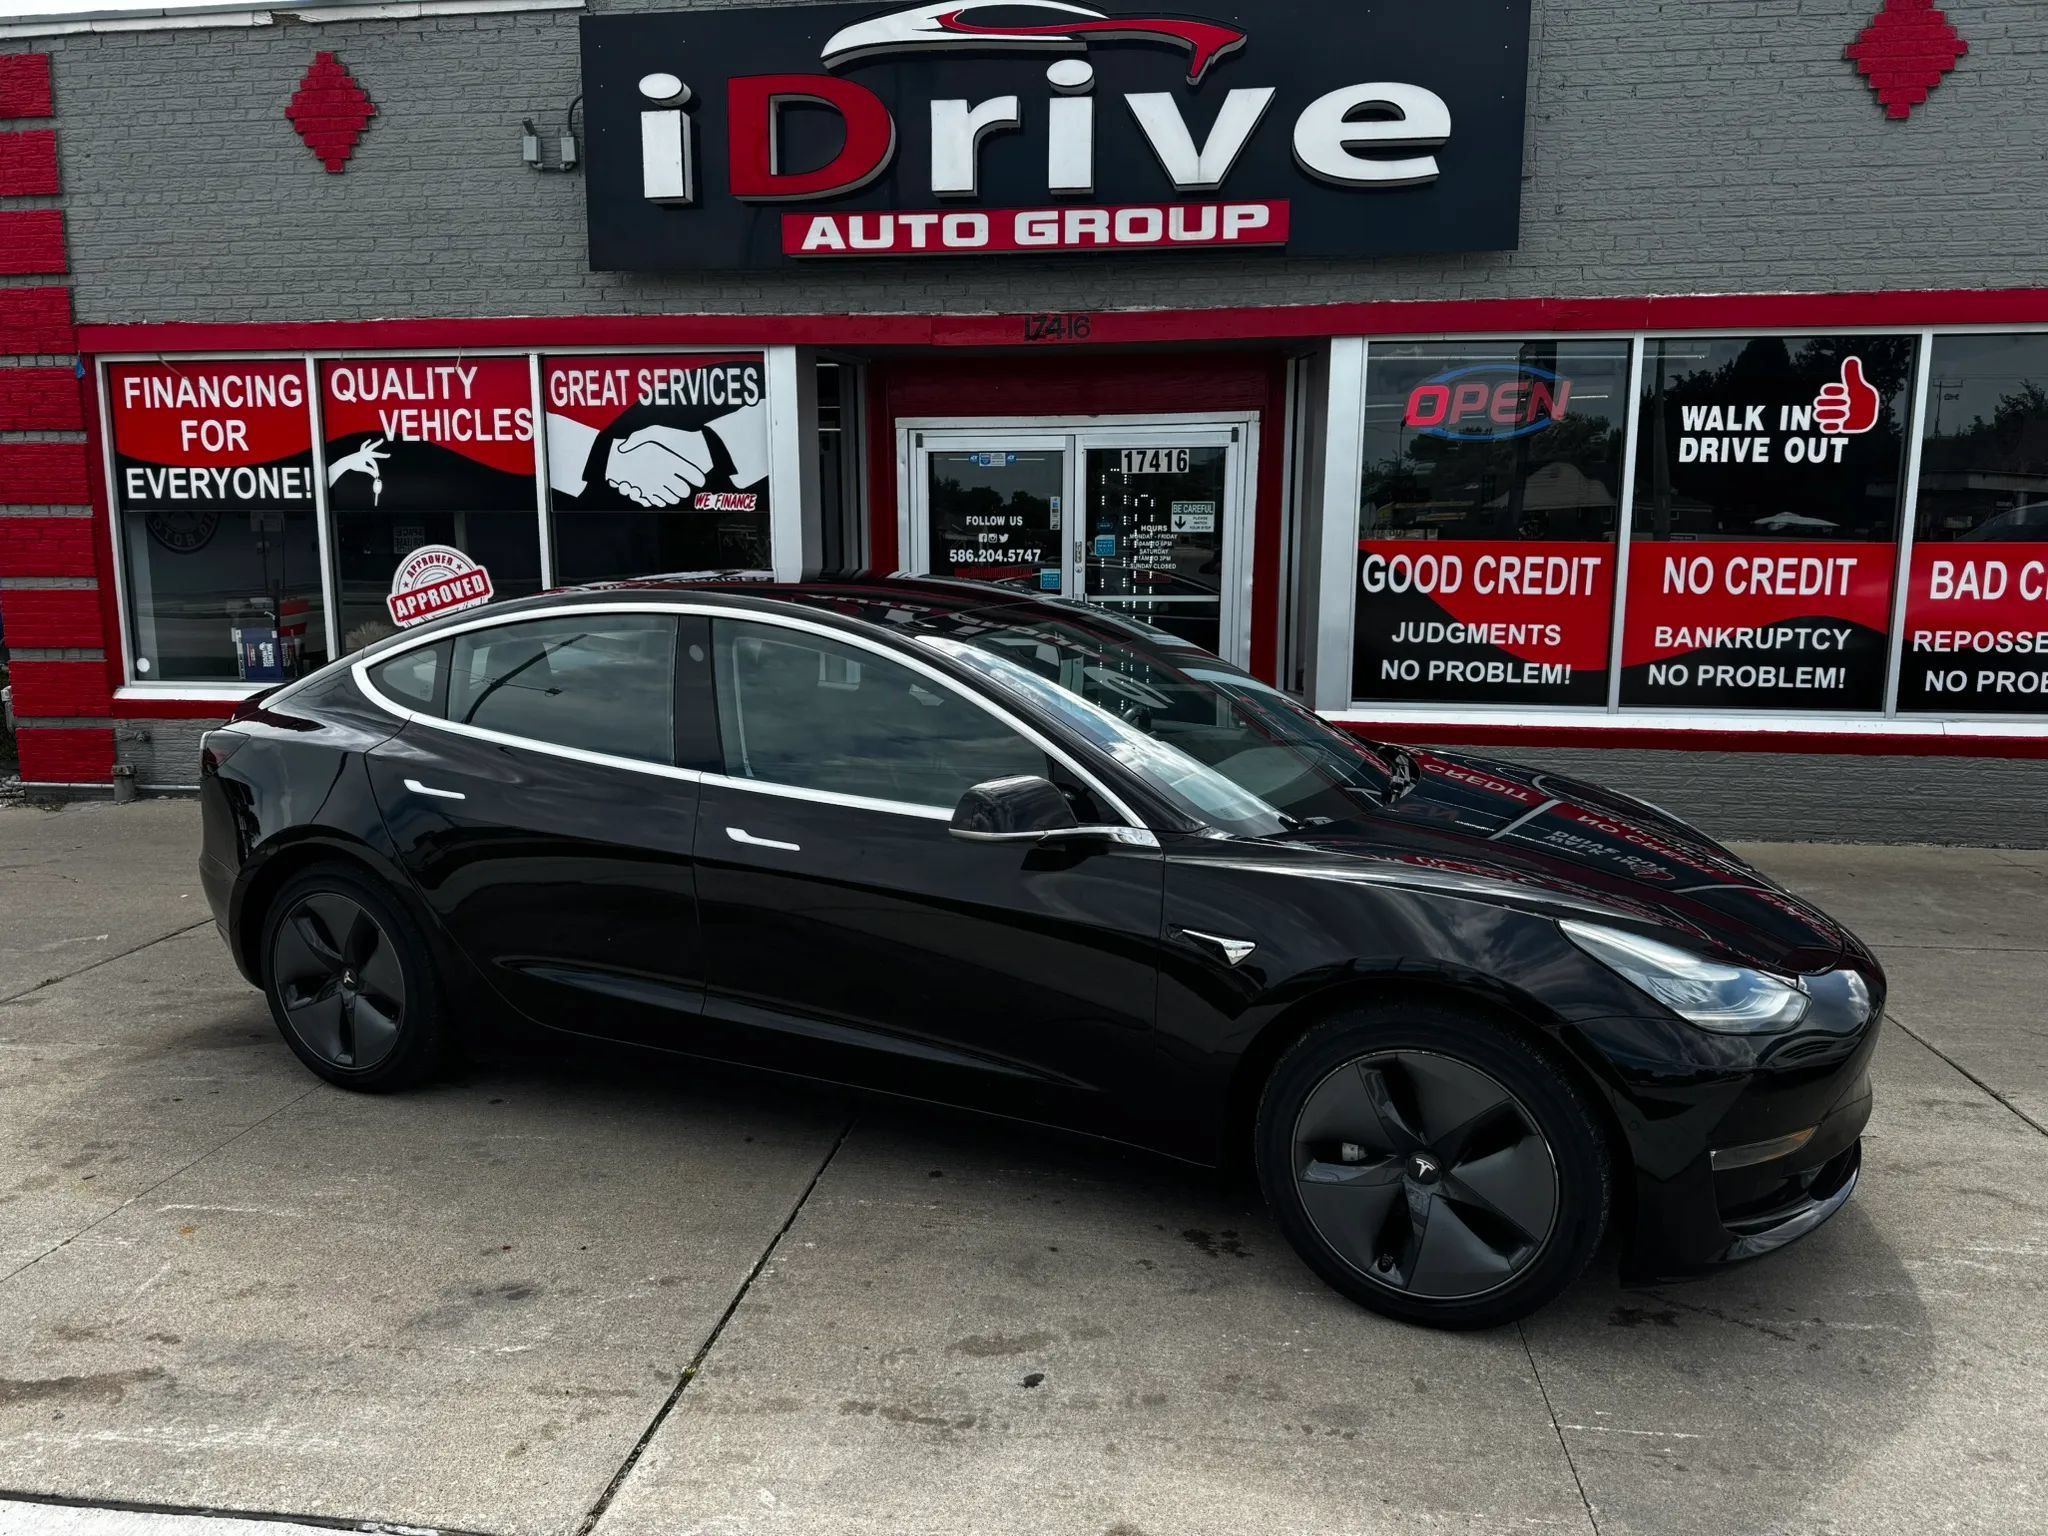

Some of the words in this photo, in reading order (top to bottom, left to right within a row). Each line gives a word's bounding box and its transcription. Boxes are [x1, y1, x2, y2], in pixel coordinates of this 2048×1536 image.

[638, 59, 1452, 204] iDrive
[801, 212, 989, 251] AUTO
[1014, 203, 1270, 246] GROUP
[123, 374, 303, 409] FINANCING
[331, 367, 478, 403] QUALITY
[550, 369, 630, 407] GREAT
[637, 367, 760, 407] SERVICES
[1403, 380, 1574, 428] OPEN
[1681, 405, 1766, 431] WALK
[1779, 405, 1813, 431] IN
[181, 420, 249, 451] FOR
[379, 408, 535, 442] VEHICLES
[1124, 450, 1188, 473] 17416
[1678, 437, 1769, 463] DRIVE
[1784, 437, 1849, 464] OUT
[126, 467, 313, 500] EVERYONE!
[694, 492, 712, 510] WE
[714, 492, 758, 512] FINANCE
[1173, 504, 1183, 513] BE
[1183, 504, 1214, 513] CAREFUL
[966, 515, 1006, 526] FOLLOW
[1009, 515, 1023, 526] US
[406, 553, 454, 579] APPROVED
[949, 549, 1042, 562] 586.204.5747
[1362, 553, 1463, 594] GOOD
[1473, 555, 1602, 596] CREDIT
[1662, 556, 1714, 595] NO
[1725, 557, 1857, 596] CREDIT
[1930, 560, 2008, 601] BAD
[2019, 560, 2048, 601] C
[394, 574, 486, 618] APPROVED
[1391, 621, 1561, 646] JUDGMENTS
[1654, 626, 1852, 651] BANKRUPTCY
[1381, 659, 1419, 681] NO
[1428, 661, 1571, 685] PROBLEM!
[1647, 664, 1688, 687] NO
[1697, 665, 1846, 689] PROBLEM!
[1925, 670, 1968, 692] NO
